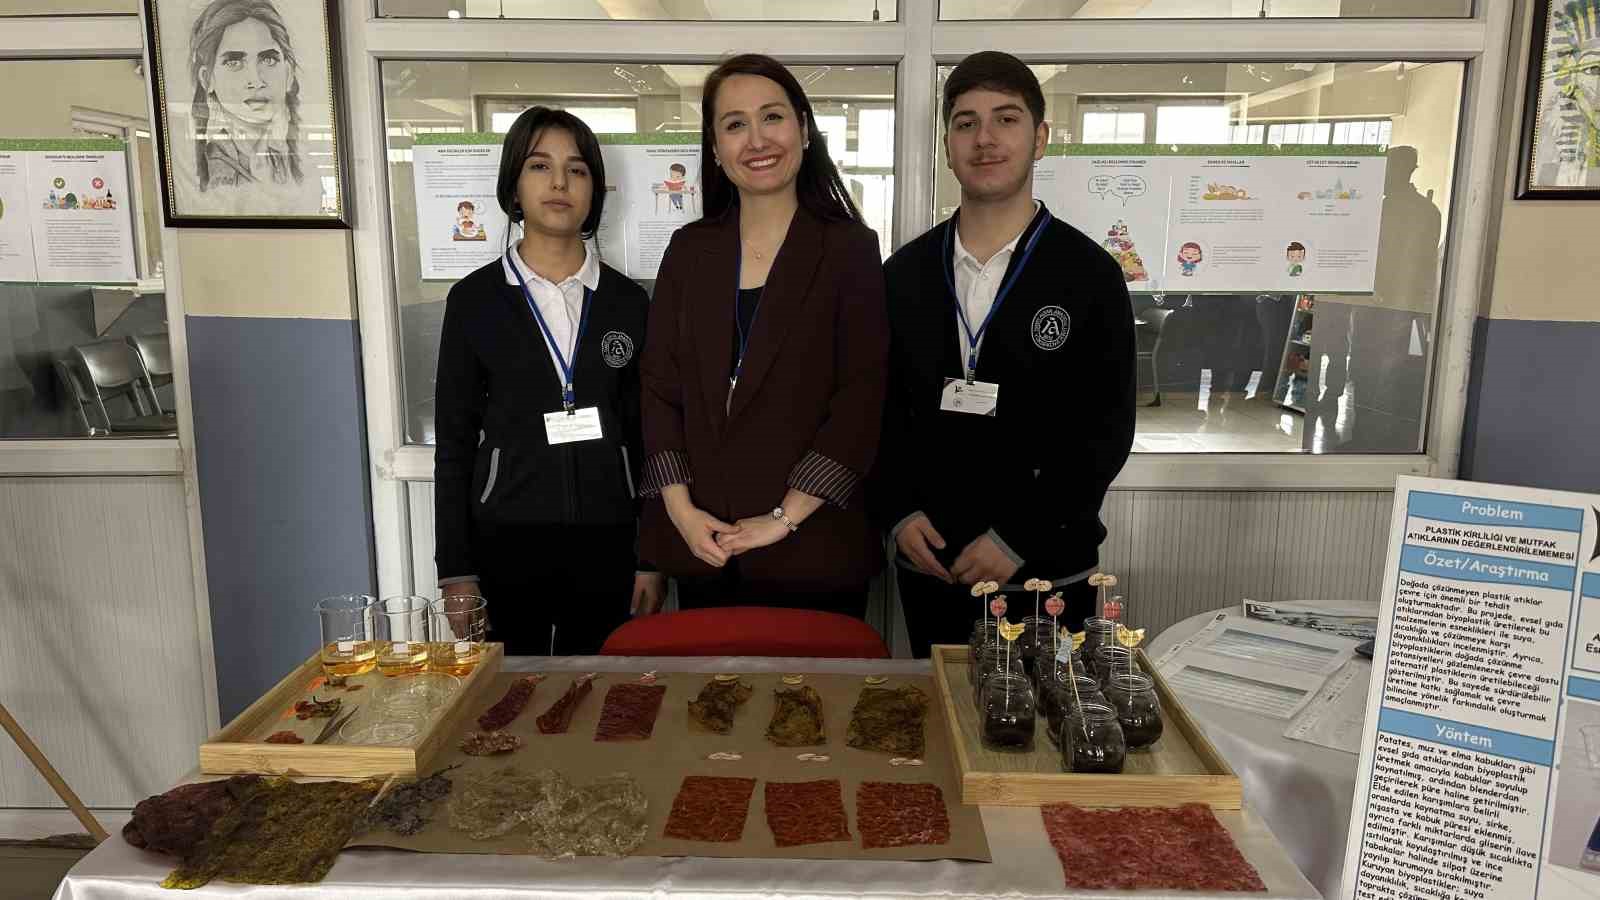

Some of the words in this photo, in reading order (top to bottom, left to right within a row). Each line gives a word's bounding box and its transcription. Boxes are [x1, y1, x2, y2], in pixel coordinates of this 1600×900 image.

[1462, 500, 1523, 519] Problem
[1408, 531, 1460, 545] ATIKLARININ
[1462, 538, 1574, 560] DEĞERLENDİRİLEMEMESİ
[1425, 524, 1461, 537] PLASTİK
[1463, 529, 1503, 542] KİRLİLİĞİ
[1505, 534, 1516, 544] VE
[1519, 536, 1556, 549] MUTFAK
[1424, 550, 1549, 581] Özet/Araştırma
[1399, 588, 1419, 596] çevre
[1424, 590, 1437, 599] için
[1440, 592, 1466, 603] önemli
[1469, 597, 1480, 605] bir
[1485, 599, 1510, 609] tehdit
[1400, 578, 1429, 588] Doğada
[1432, 583, 1479, 596] çözünmeyen
[1482, 590, 1510, 601] plastik
[1514, 595, 1542, 605] atıklar
[1396, 614, 1446, 627] malzemelerin
[1499, 629, 1509, 638] ile
[1397, 604, 1443, 618] atıklarından
[1447, 612, 1490, 625] biyoplastik
[1494, 619, 1536, 633] üretilerek
[1539, 626, 1550, 635] bu
[1467, 606, 1478, 614] Bu
[1520, 616, 1542, 624] evsel
[1544, 619, 1563, 628] gıda
[1395, 624, 1424, 634] sıcaklığa
[1443, 631, 1486, 644] çözünmeye
[1490, 638, 1511, 648] karşı
[1391, 649, 1444, 664] potansiyelleri
[1446, 659, 1505, 675] gözlemlenerek
[1508, 671, 1532, 680] çevre
[1535, 673, 1559, 685] dostu
[1392, 639, 1452, 656] biyoplastiklerin
[1454, 650, 1484, 662] doğada
[1487, 657, 1522, 669] çözünme
[1390, 657, 1429, 670] alternatif
[1431, 665, 1476, 679] plastiklerin
[1480, 673, 1540, 691] üretilebileceği
[1386, 683, 1418, 696] bilincine
[1452, 696, 1497, 711] farkındalık
[1499, 706, 1546, 721] oluşturmak
[1387, 675, 1418, 687] üretime
[1420, 681, 1441, 691] katkı
[1444, 687, 1482, 699] sağlamak
[1497, 698, 1521, 707] çevre
[1448, 677, 1459, 686] Bu
[1462, 682, 1490, 691] sayede
[1494, 686, 1551, 703] sürdürülebilir
[1434, 723, 1493, 747] Yöntem
[1377, 753, 1411, 767] üretmek
[1414, 763, 1451, 776] amacıyla
[1454, 770, 1492, 785] kabuklar
[1495, 781, 1528, 794] soyulup
[1378, 745, 1399, 754] evsel
[1401, 750, 1419, 759] gıda
[1422, 754, 1474, 771] atıklarından
[1477, 765, 1526, 782] biyoplastik
[1418, 744, 1434, 752] muz
[1451, 750, 1471, 760] elma
[1475, 754, 1516, 769] kabukları
[1519, 764, 1536, 774] gibi
[1372, 781, 1391, 792] Elde
[1394, 787, 1419, 799] edilen
[1422, 793, 1470, 811] karışımlara
[1473, 805, 1500, 818] belirli
[1373, 774, 1418, 788] geçirilerek
[1421, 784, 1441, 794] püre
[1444, 788, 1470, 800] haline
[1428, 776, 1467, 789] ardından
[1469, 783, 1519, 801] blenderdan
[1370, 801, 1399, 814] nişasta
[1416, 811, 1441, 824] kabuk
[1444, 819, 1471, 832] püresi
[1371, 793, 1411, 807] oranlarda
[1414, 801, 1456, 817] kaynatma
[1368, 812, 1395, 823] ayrıca
[1398, 817, 1421, 829] farklı
[1424, 825, 1476, 843] miktarlarda
[1479, 838, 1512, 852] gliserin
[1515, 846, 1537, 858] ilave
[1413, 831, 1458, 849] Karışımlar
[1460, 843, 1486, 856] düşük
[1489, 853, 1533, 868] sıcaklıkta
[1363, 851, 1390, 864] yayılıp
[1393, 857, 1434, 874] kurumaya
[1364, 839, 1405, 856] tabakalar
[1408, 850, 1439, 865] halinde
[1442, 860, 1466, 872] silpat
[1470, 866, 1503, 882] üzerine
[1366, 831, 1403, 845] ısıtılarak
[1406, 840, 1468, 863] koyulaştırılmış
[1471, 858, 1481, 866] ve
[1485, 860, 1503, 871] ince
[1359, 878, 1395, 894] toprakta
[1362, 858, 1395, 874] Kuruyan
[1463, 888, 1484, 898] suya
[1414, 885, 1451, 899] sıcaklığa
[1358, 887, 1376, 899] test
